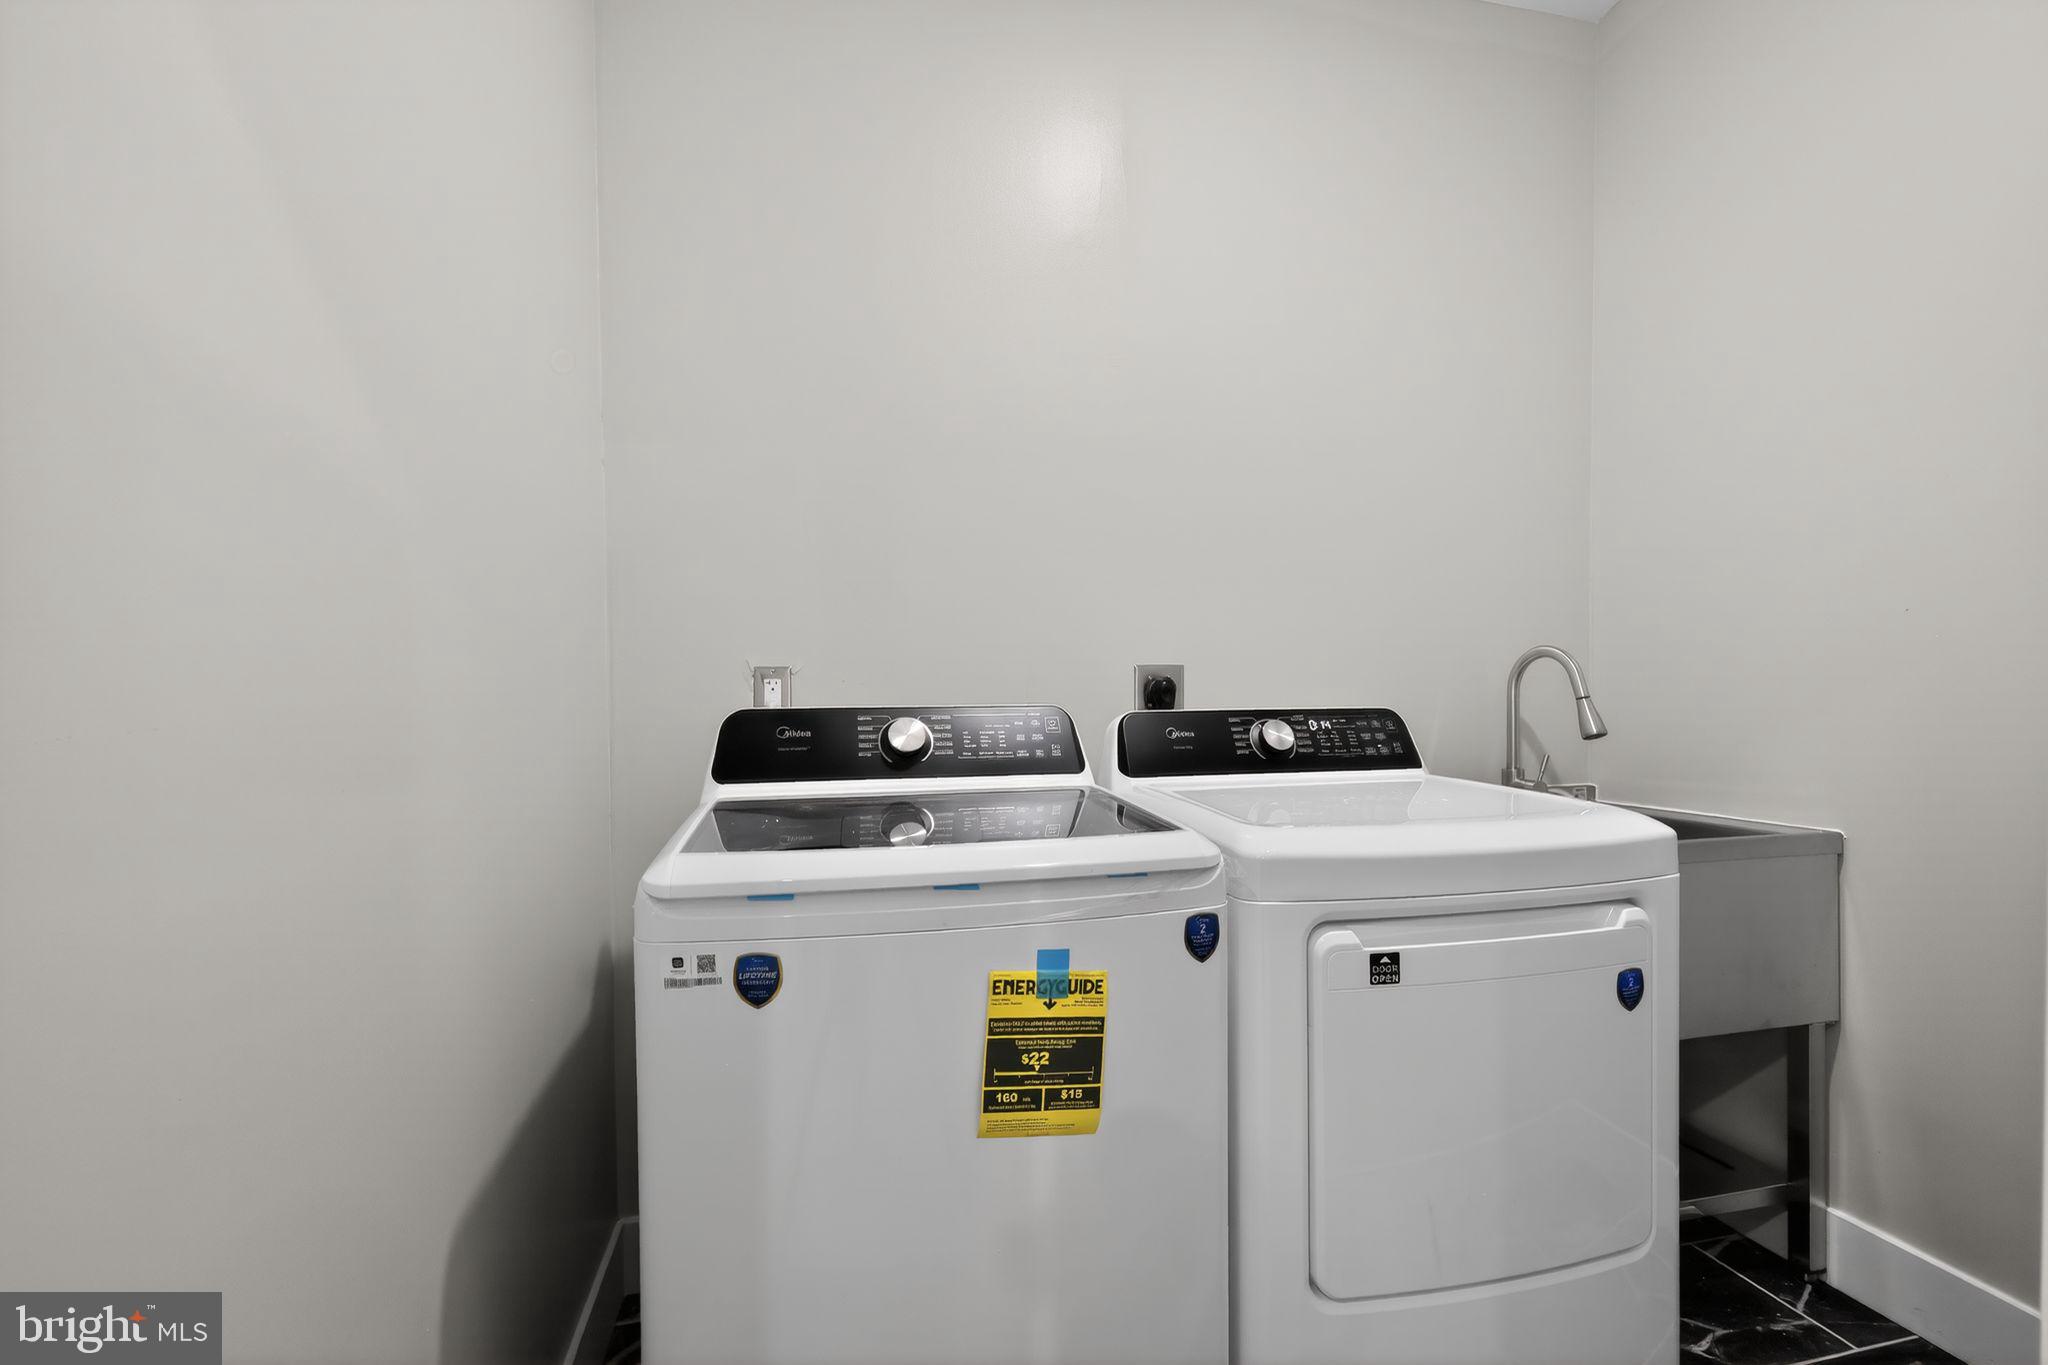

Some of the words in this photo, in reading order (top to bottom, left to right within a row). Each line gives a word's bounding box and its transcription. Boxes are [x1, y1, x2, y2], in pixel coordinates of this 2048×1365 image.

[1372, 964, 1399, 974] DOOR
[1371, 974, 1399, 984] OPEN
[991, 979, 1105, 996] ENERGYGUIDE
[1021, 1051, 1051, 1066] $22
